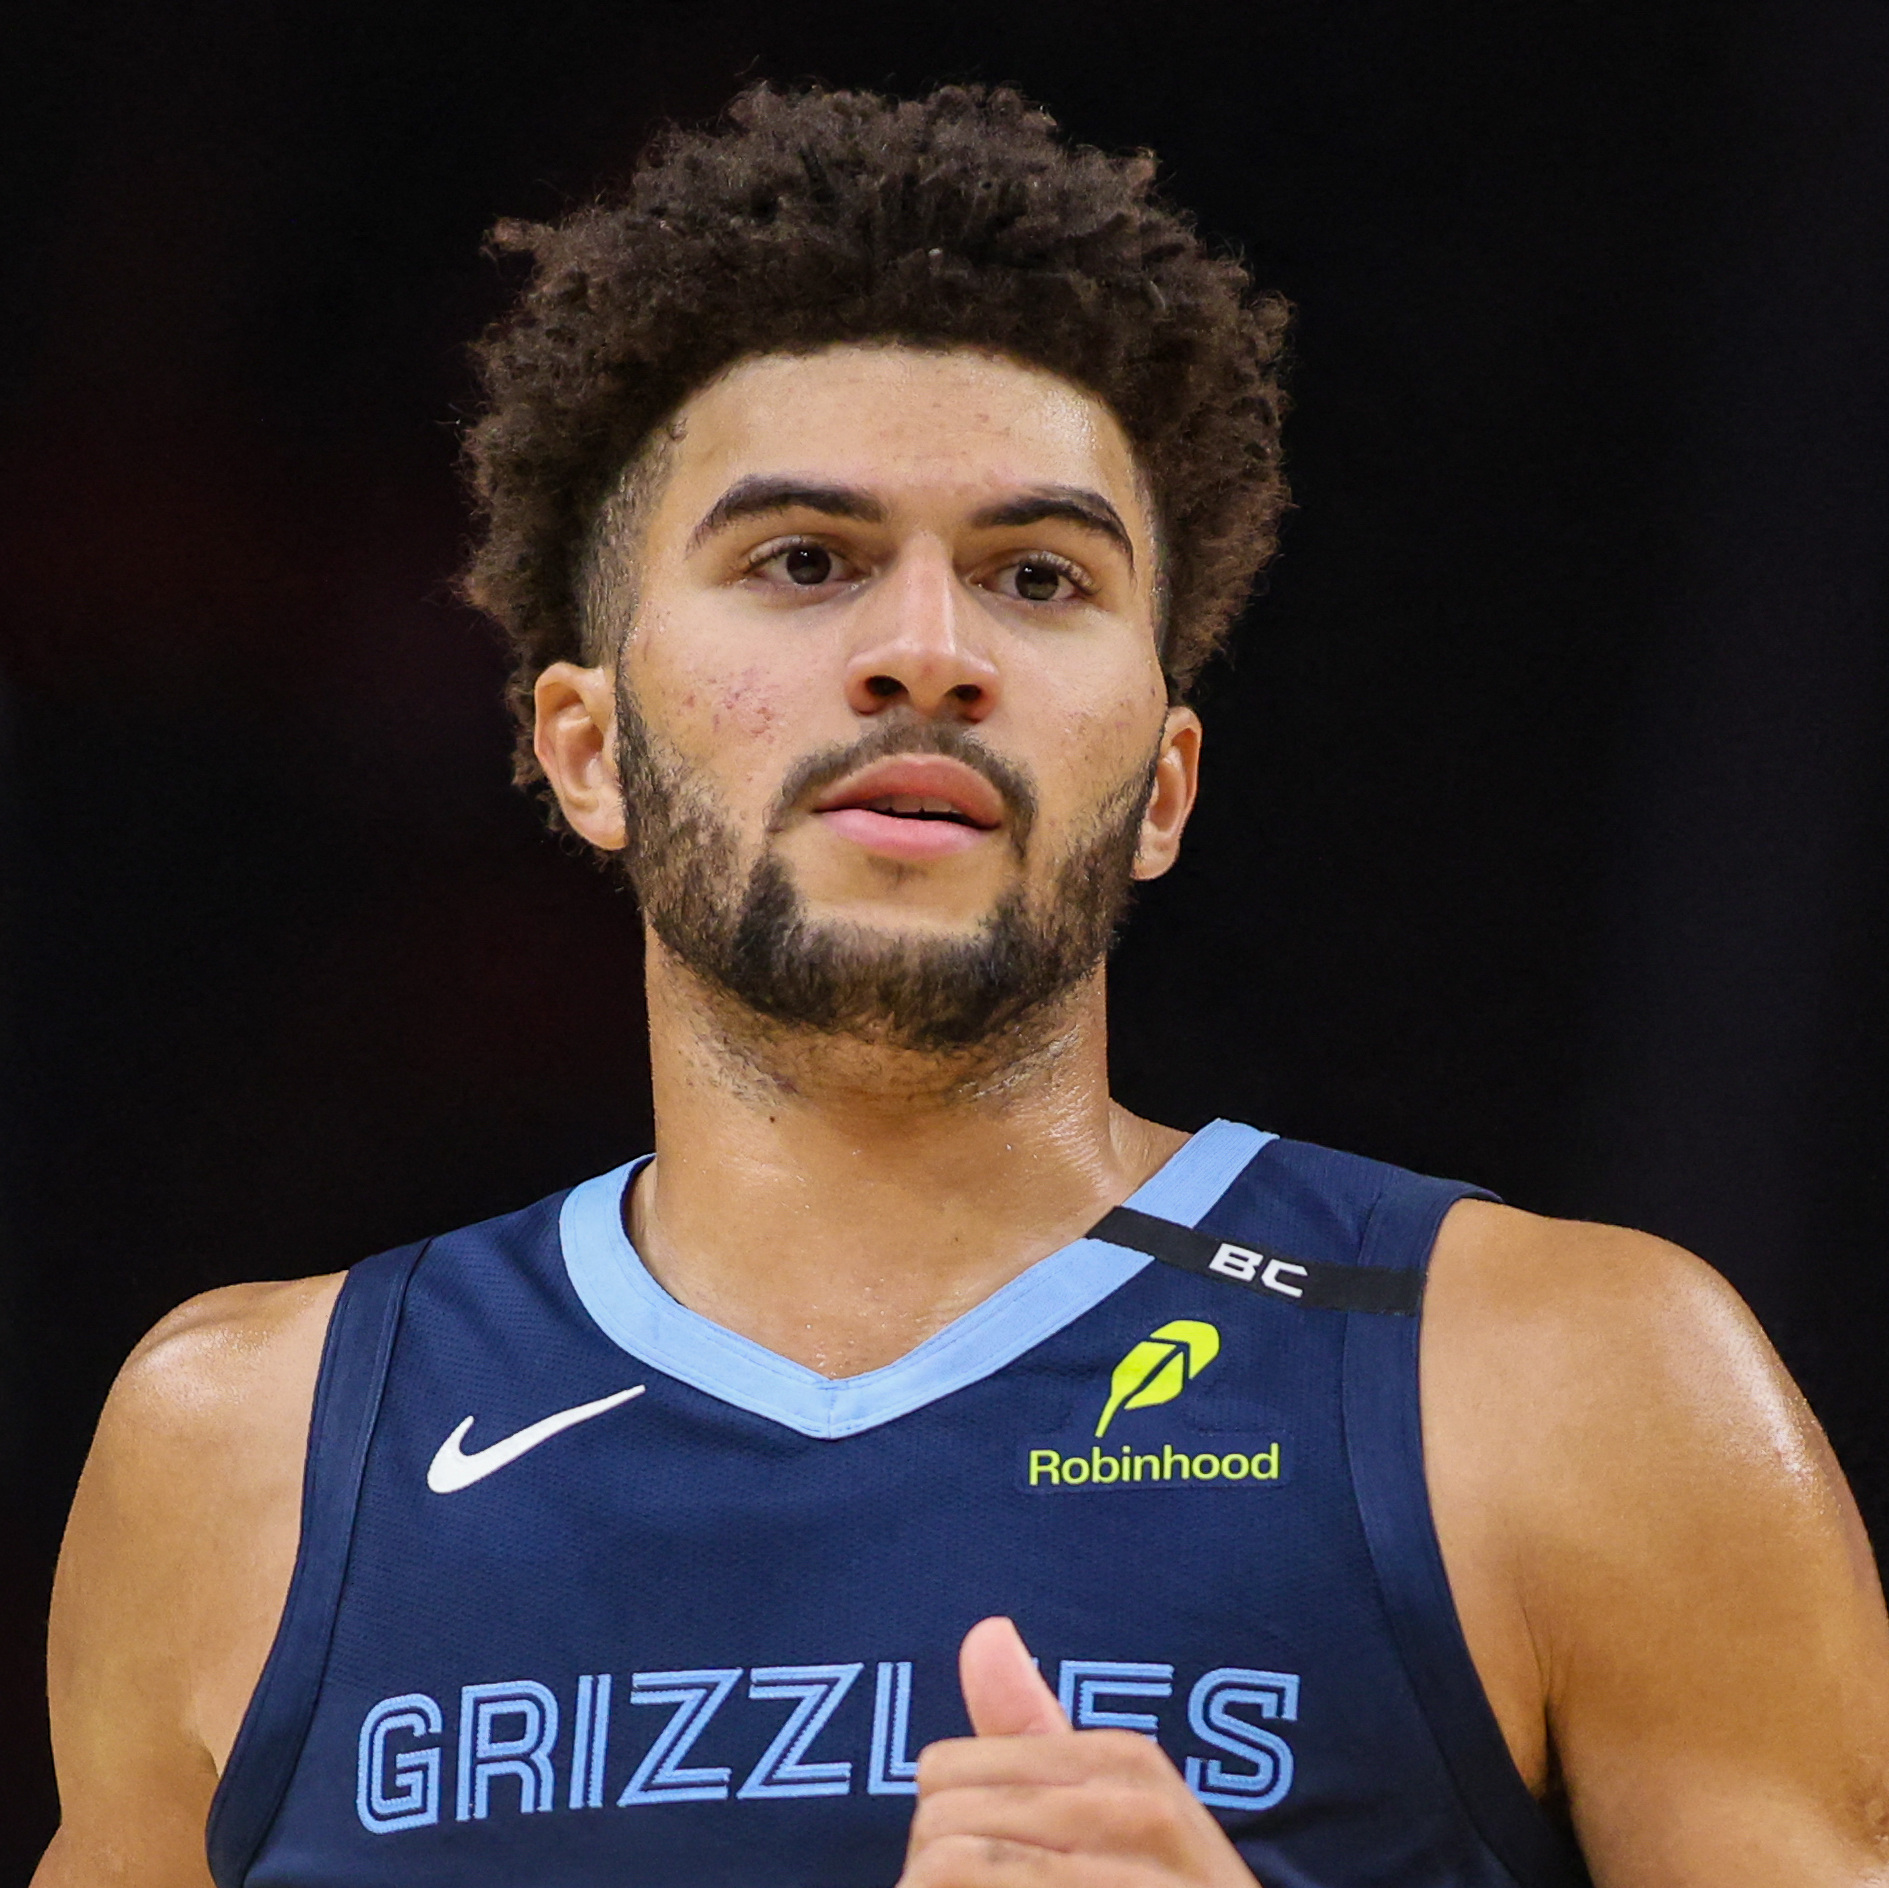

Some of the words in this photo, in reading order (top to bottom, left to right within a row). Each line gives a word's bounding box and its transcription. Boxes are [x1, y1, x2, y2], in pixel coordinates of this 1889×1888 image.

[1209, 1242, 1309, 1298] BC
[1029, 1443, 1279, 1486] Robinhood
[357, 1660, 1299, 1834] GRIZZLES
